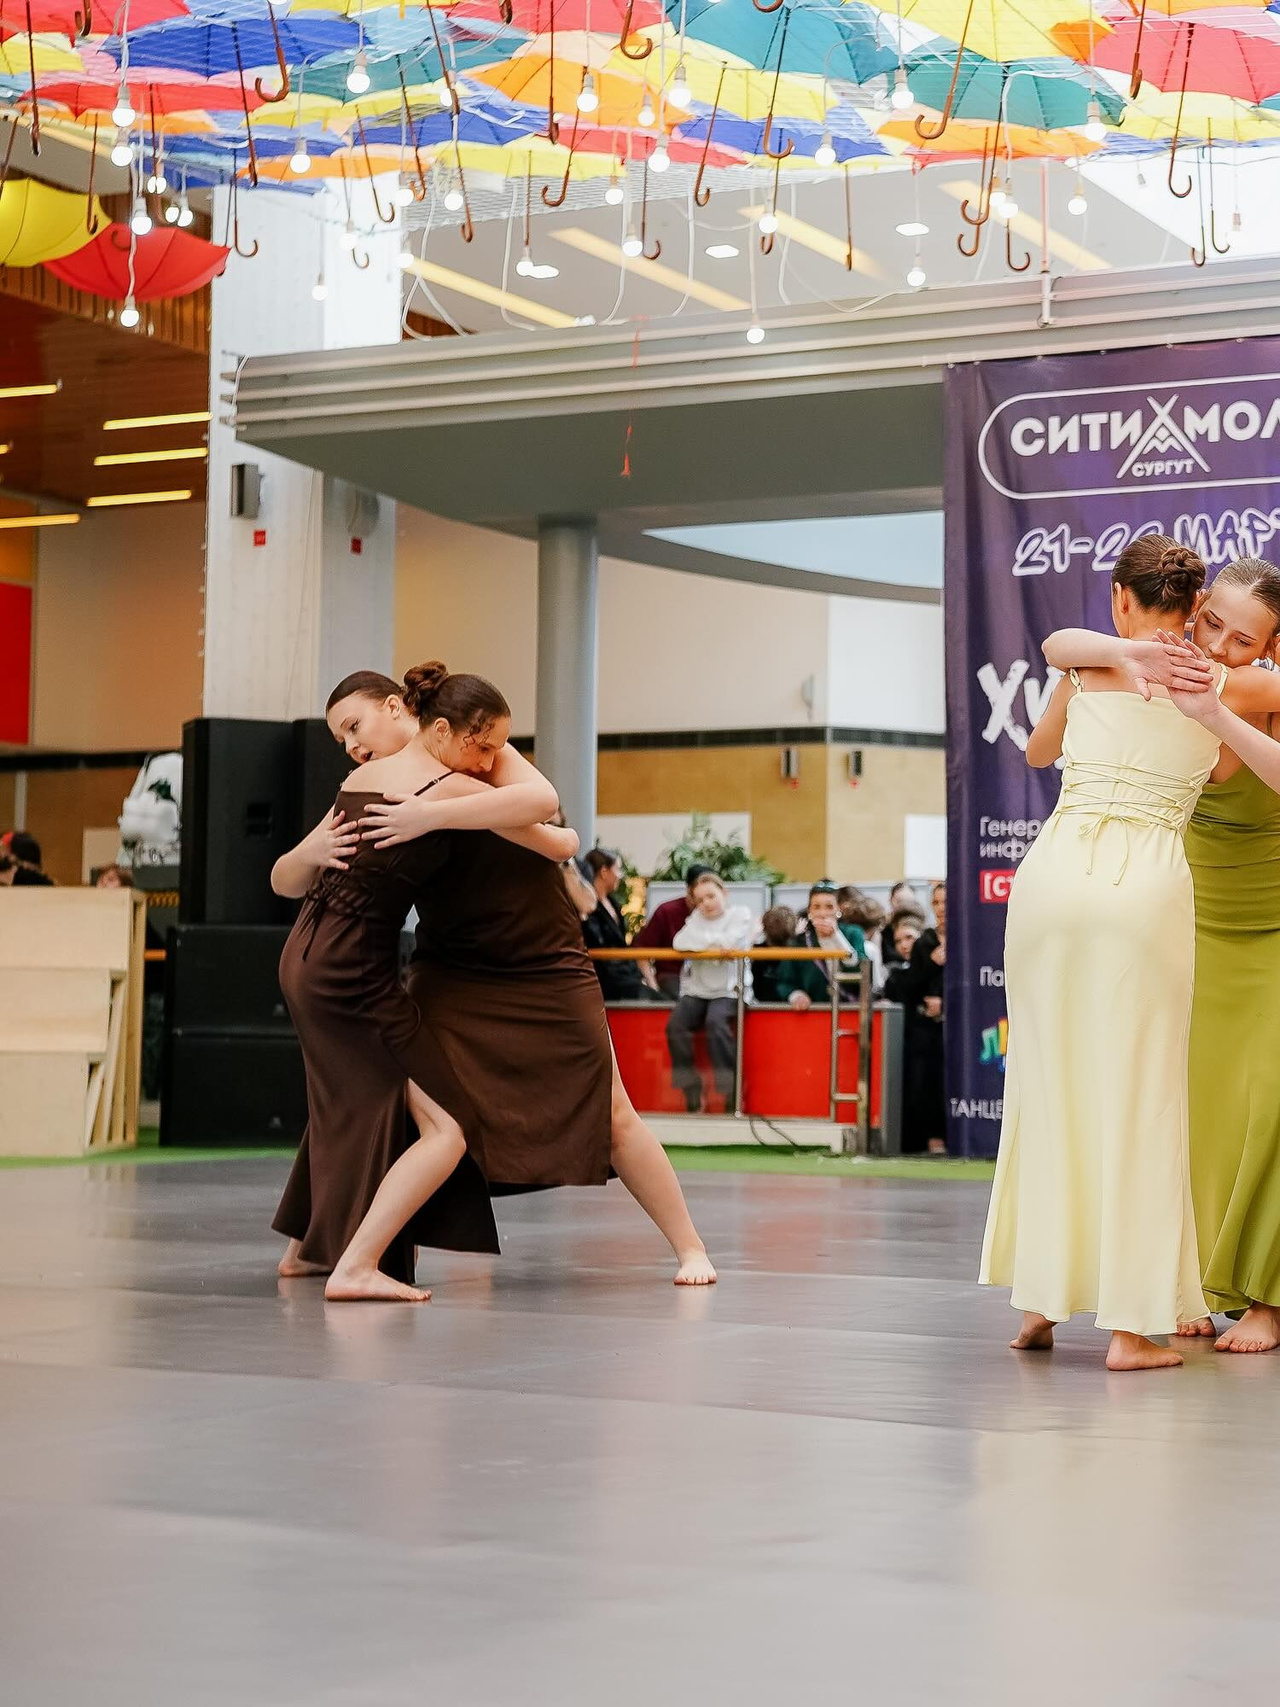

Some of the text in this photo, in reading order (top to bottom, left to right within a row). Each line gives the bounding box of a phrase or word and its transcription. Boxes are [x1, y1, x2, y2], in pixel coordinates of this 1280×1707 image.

[1010, 408, 1143, 457] СИТИ
[1131, 457, 1195, 477] СУРГУТ
[1012, 519, 1166, 577] 21-2
[980, 816, 1046, 840] Генер
[980, 837, 1033, 862] инф
[950, 1097, 1003, 1121] ТАНЦЕ
